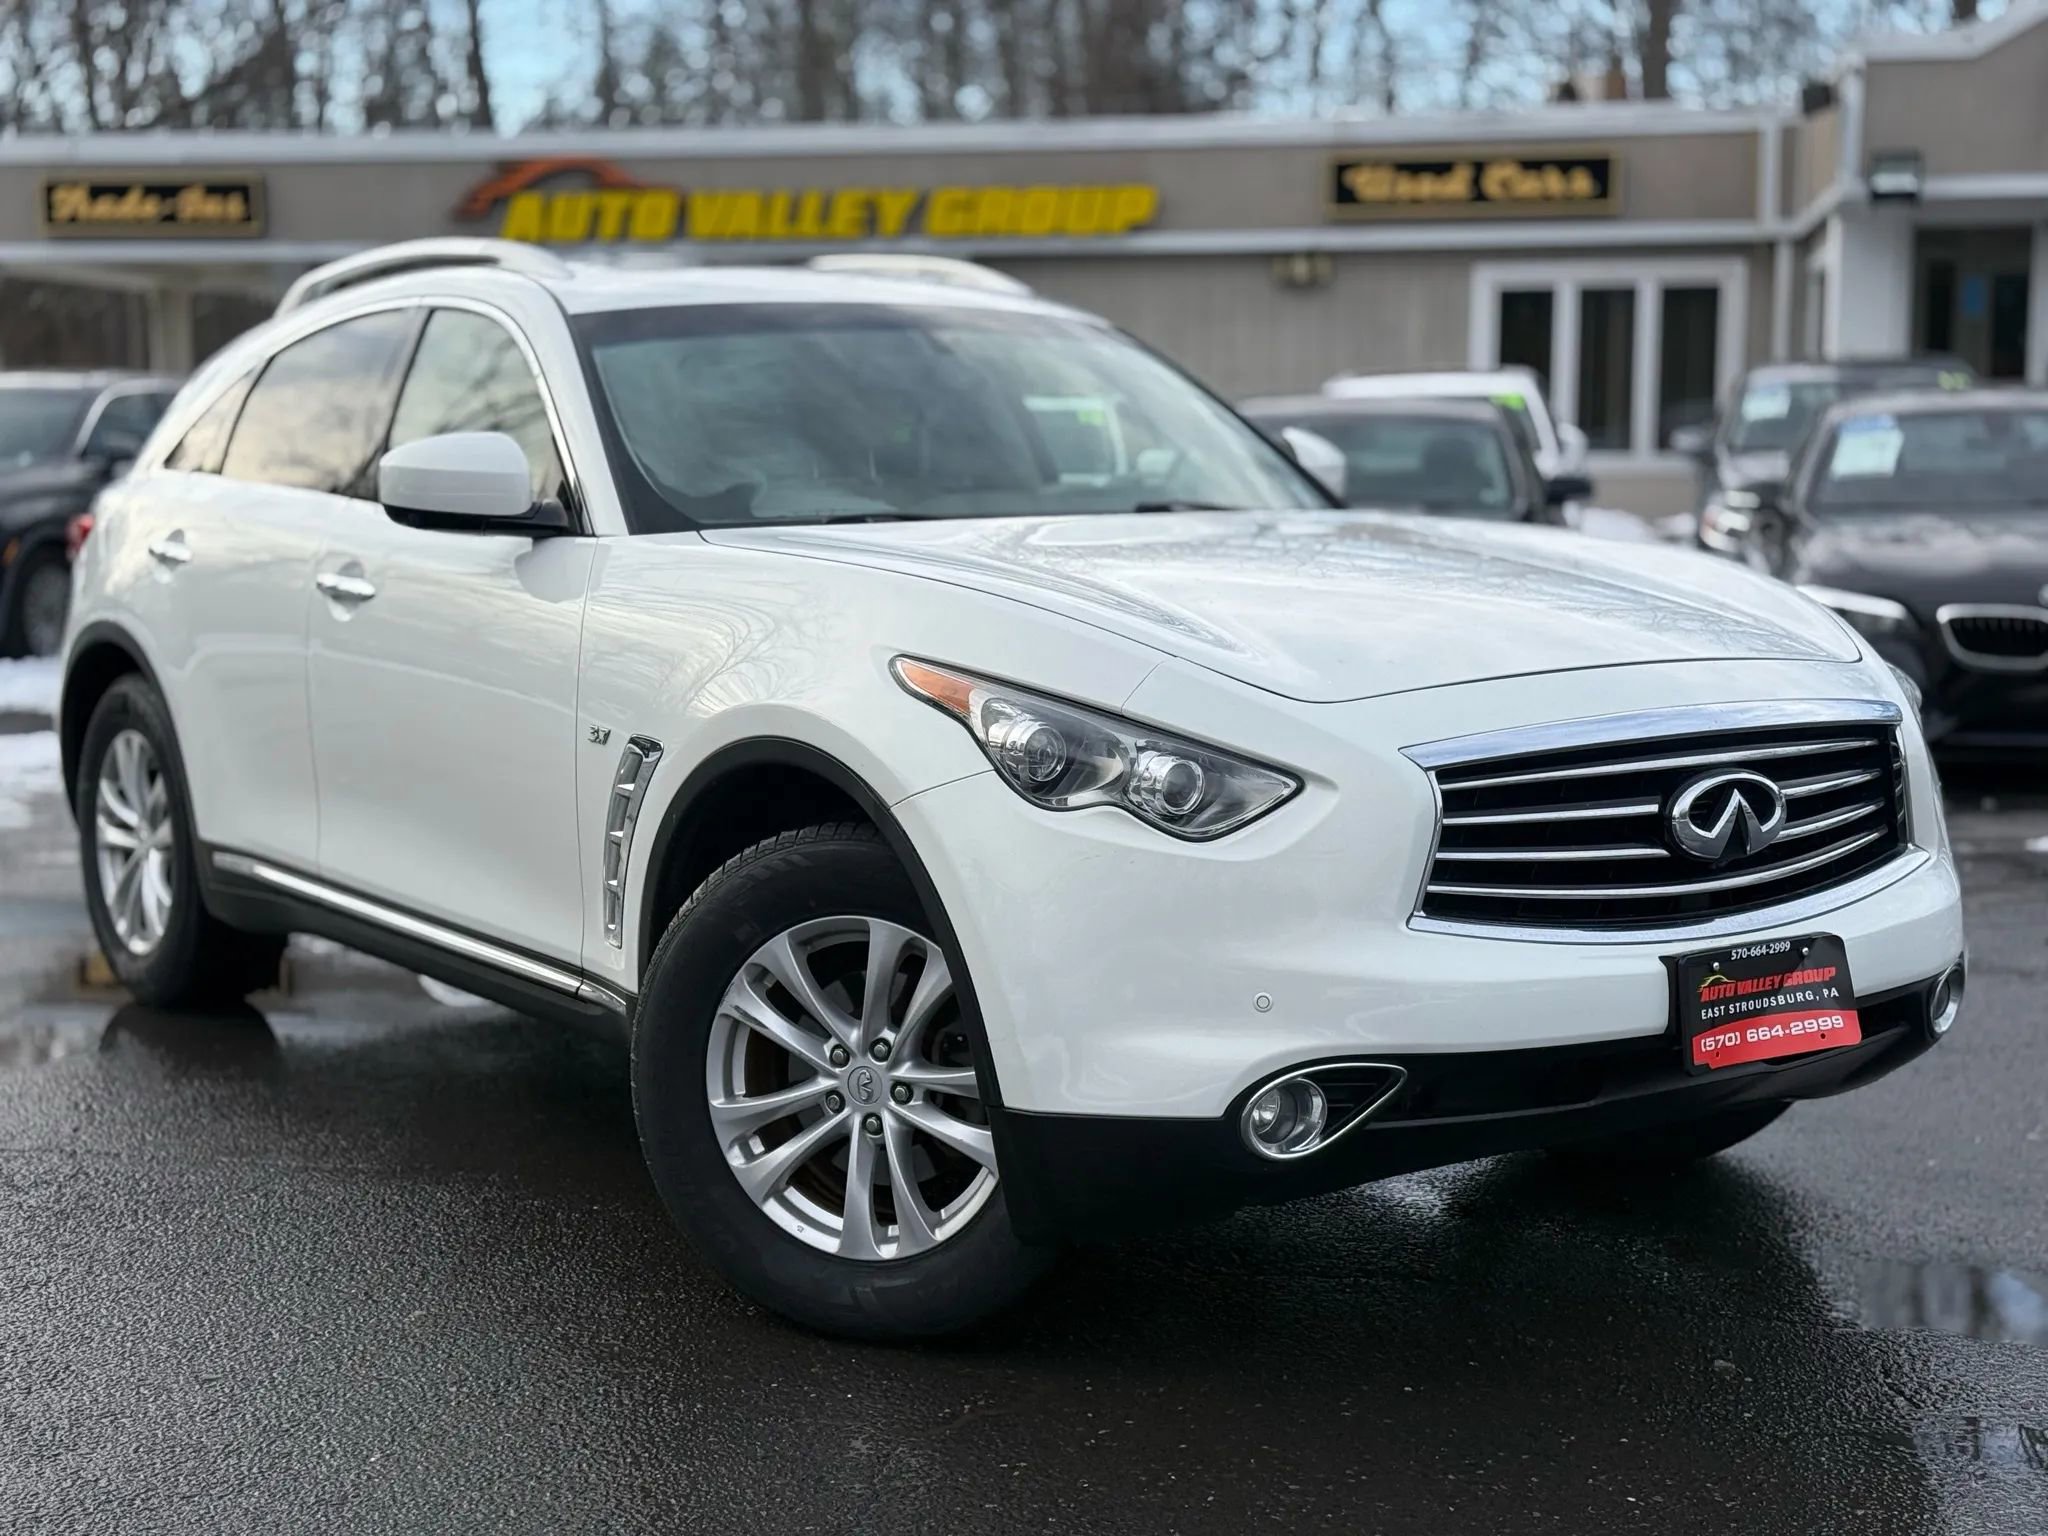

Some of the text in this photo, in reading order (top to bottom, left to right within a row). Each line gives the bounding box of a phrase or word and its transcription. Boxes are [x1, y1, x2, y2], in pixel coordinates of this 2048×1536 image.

[502, 184, 1159, 242] AUTO VALLEY GROUP
[1731, 941, 1791, 960] 570-664-2999
[1701, 967, 1835, 1001] AUTO VALLEY GROUP
[1701, 987, 1839, 1020] EAST STROUDSBURG, PA
[1701, 1032, 1741, 1052] (570)
